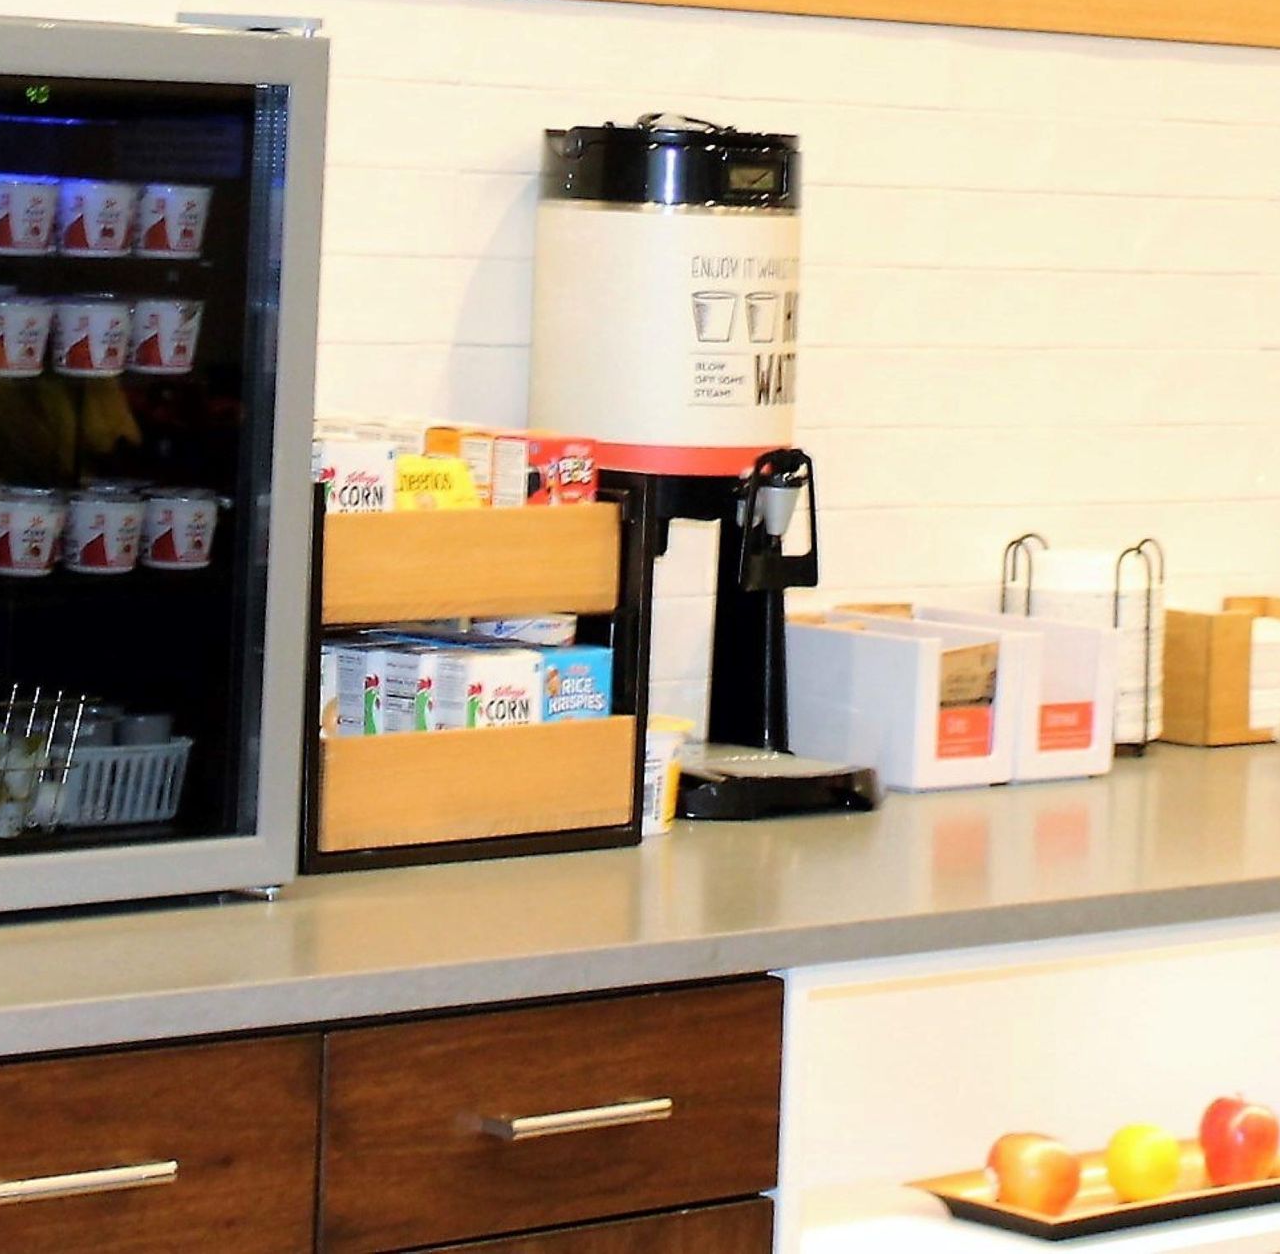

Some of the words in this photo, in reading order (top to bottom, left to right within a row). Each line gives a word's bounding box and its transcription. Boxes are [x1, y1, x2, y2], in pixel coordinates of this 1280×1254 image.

[691, 255, 738, 280] ENJOY
[338, 485, 384, 507] CORN
[560, 677, 593, 695] RICE
[486, 699, 530, 721] CORN
